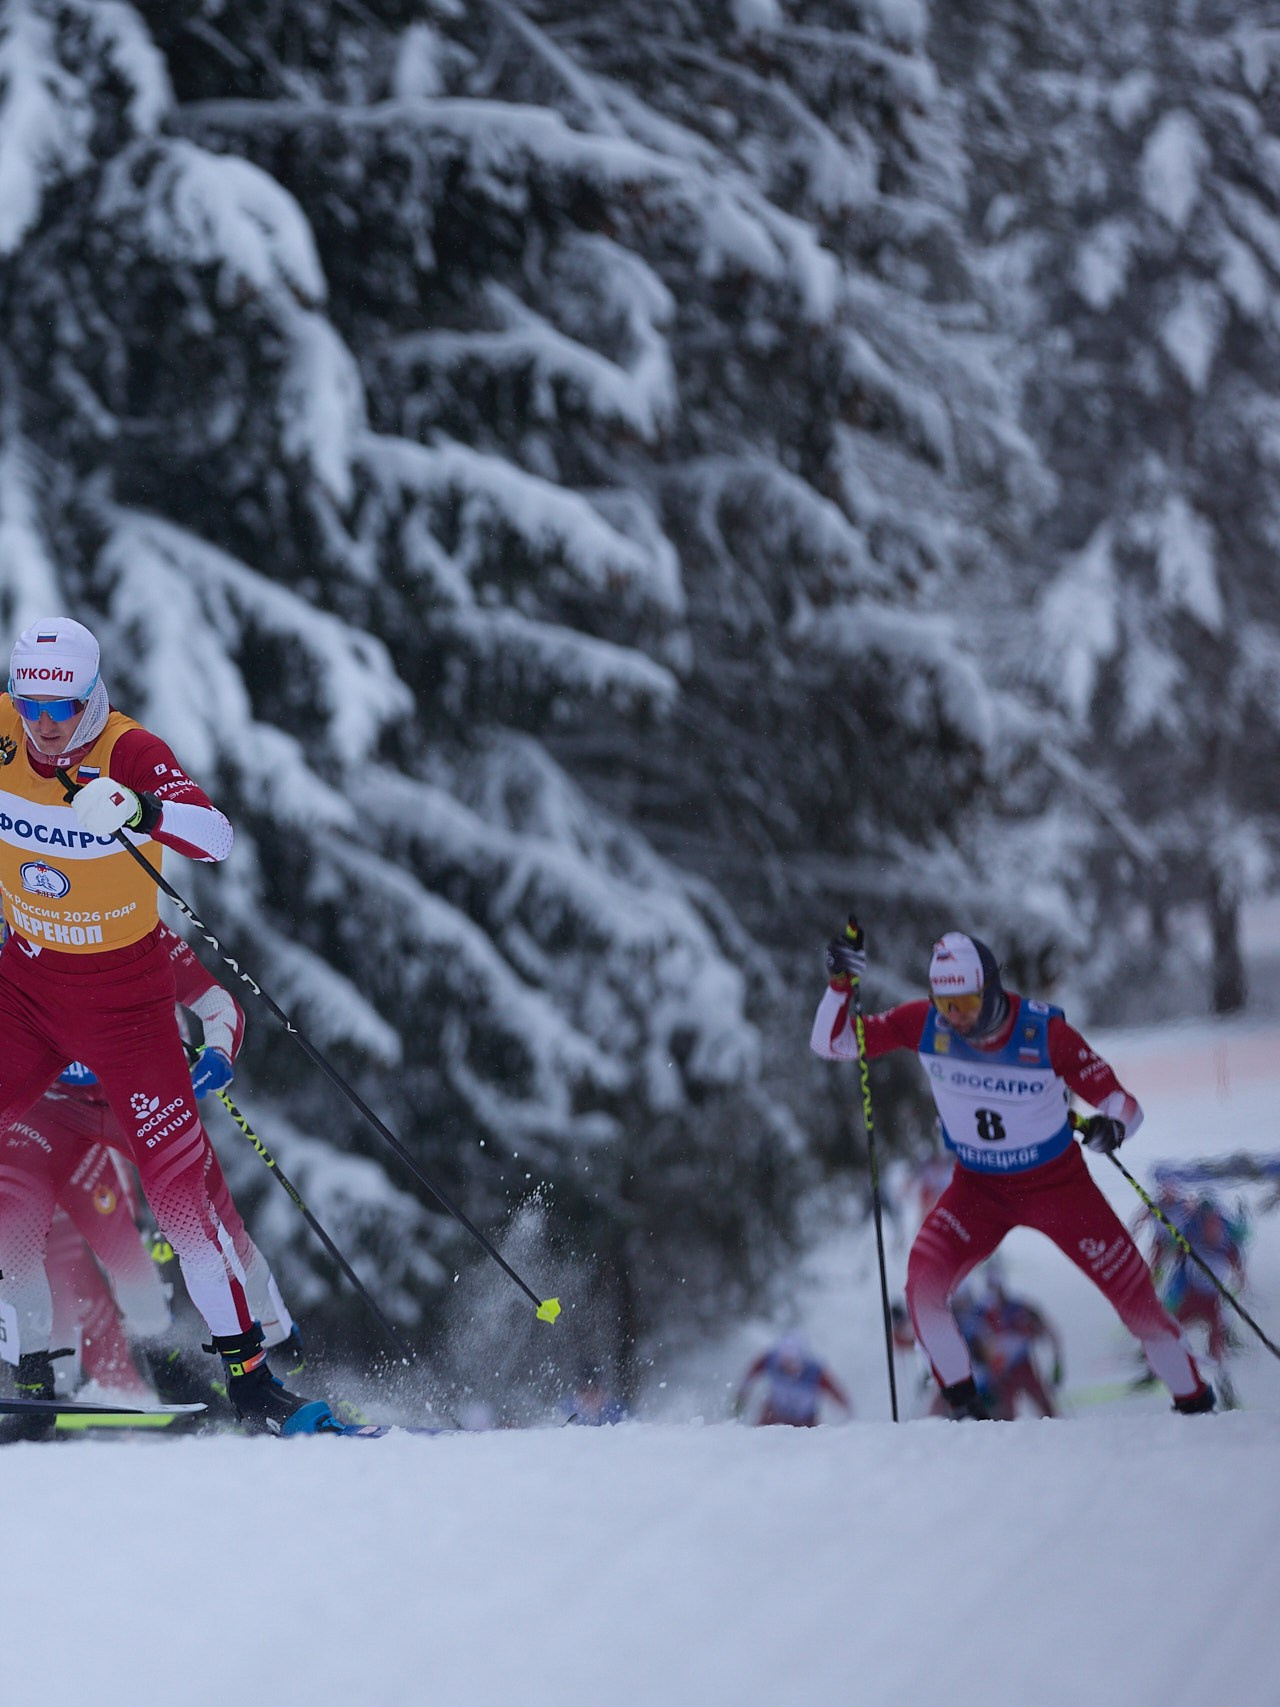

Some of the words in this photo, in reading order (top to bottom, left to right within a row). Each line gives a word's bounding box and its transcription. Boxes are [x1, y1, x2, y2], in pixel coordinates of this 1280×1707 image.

[11, 904, 104, 946] ПЕРЕКОП
[14, 895, 60, 920] России
[63, 911, 101, 923] 2026
[104, 901, 137, 921] года
[951, 1071, 1044, 1095] ФОСАГРО
[136, 1097, 184, 1138] ФОСАГРО
[145, 1109, 192, 1149] BIVIUM
[975, 1107, 1006, 1141] 8
